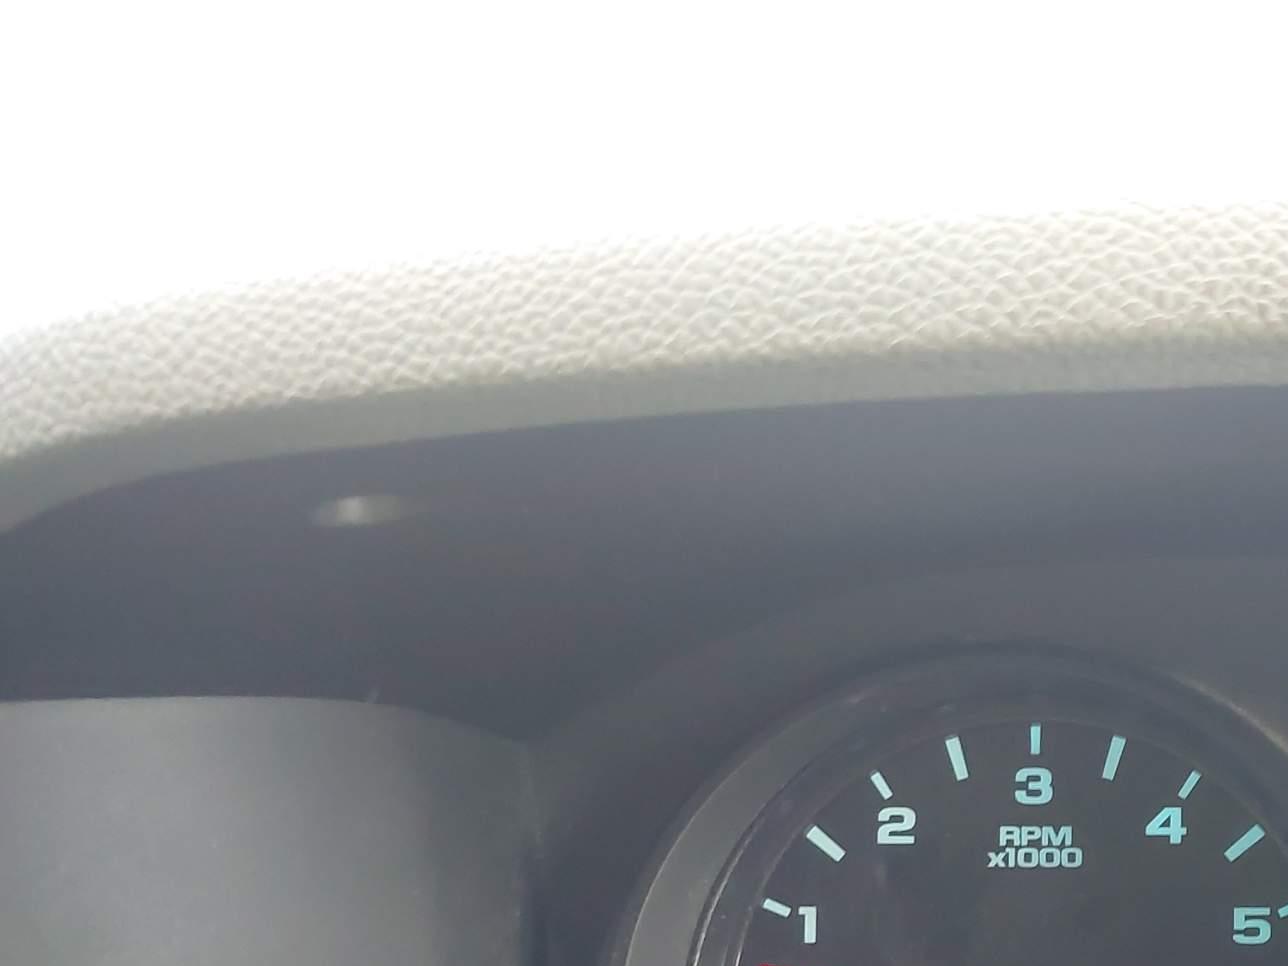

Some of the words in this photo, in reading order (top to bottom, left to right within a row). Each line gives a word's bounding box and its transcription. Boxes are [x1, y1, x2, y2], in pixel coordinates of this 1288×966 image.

[1014, 767, 1053, 805] 3
[877, 807, 915, 845] 2
[999, 826, 1072, 846] RPM
[1145, 807, 1187, 844] 4
[987, 848, 1082, 868] x1000
[799, 906, 817, 943] 1
[1233, 907, 1271, 944] 5
